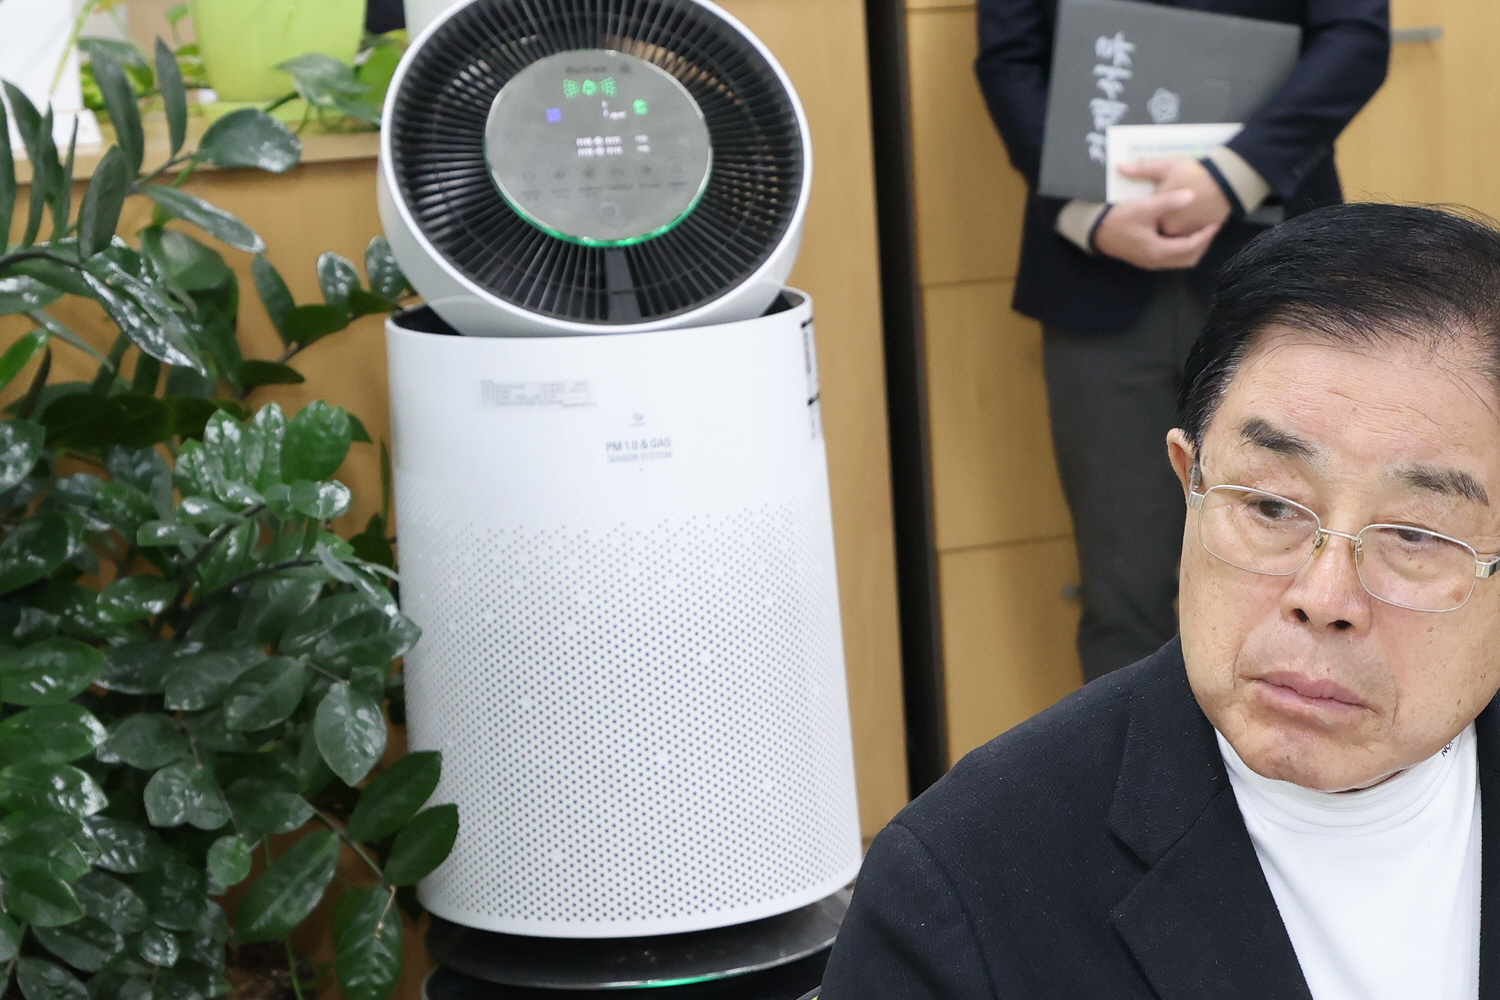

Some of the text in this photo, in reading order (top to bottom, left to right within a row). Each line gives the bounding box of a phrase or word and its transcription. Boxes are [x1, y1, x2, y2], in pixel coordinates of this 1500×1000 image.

[605, 441, 622, 451] PM
[640, 439, 647, 449] &
[650, 437, 671, 448] GAS
[607, 451, 672, 462] SENSOR SYSTEM
